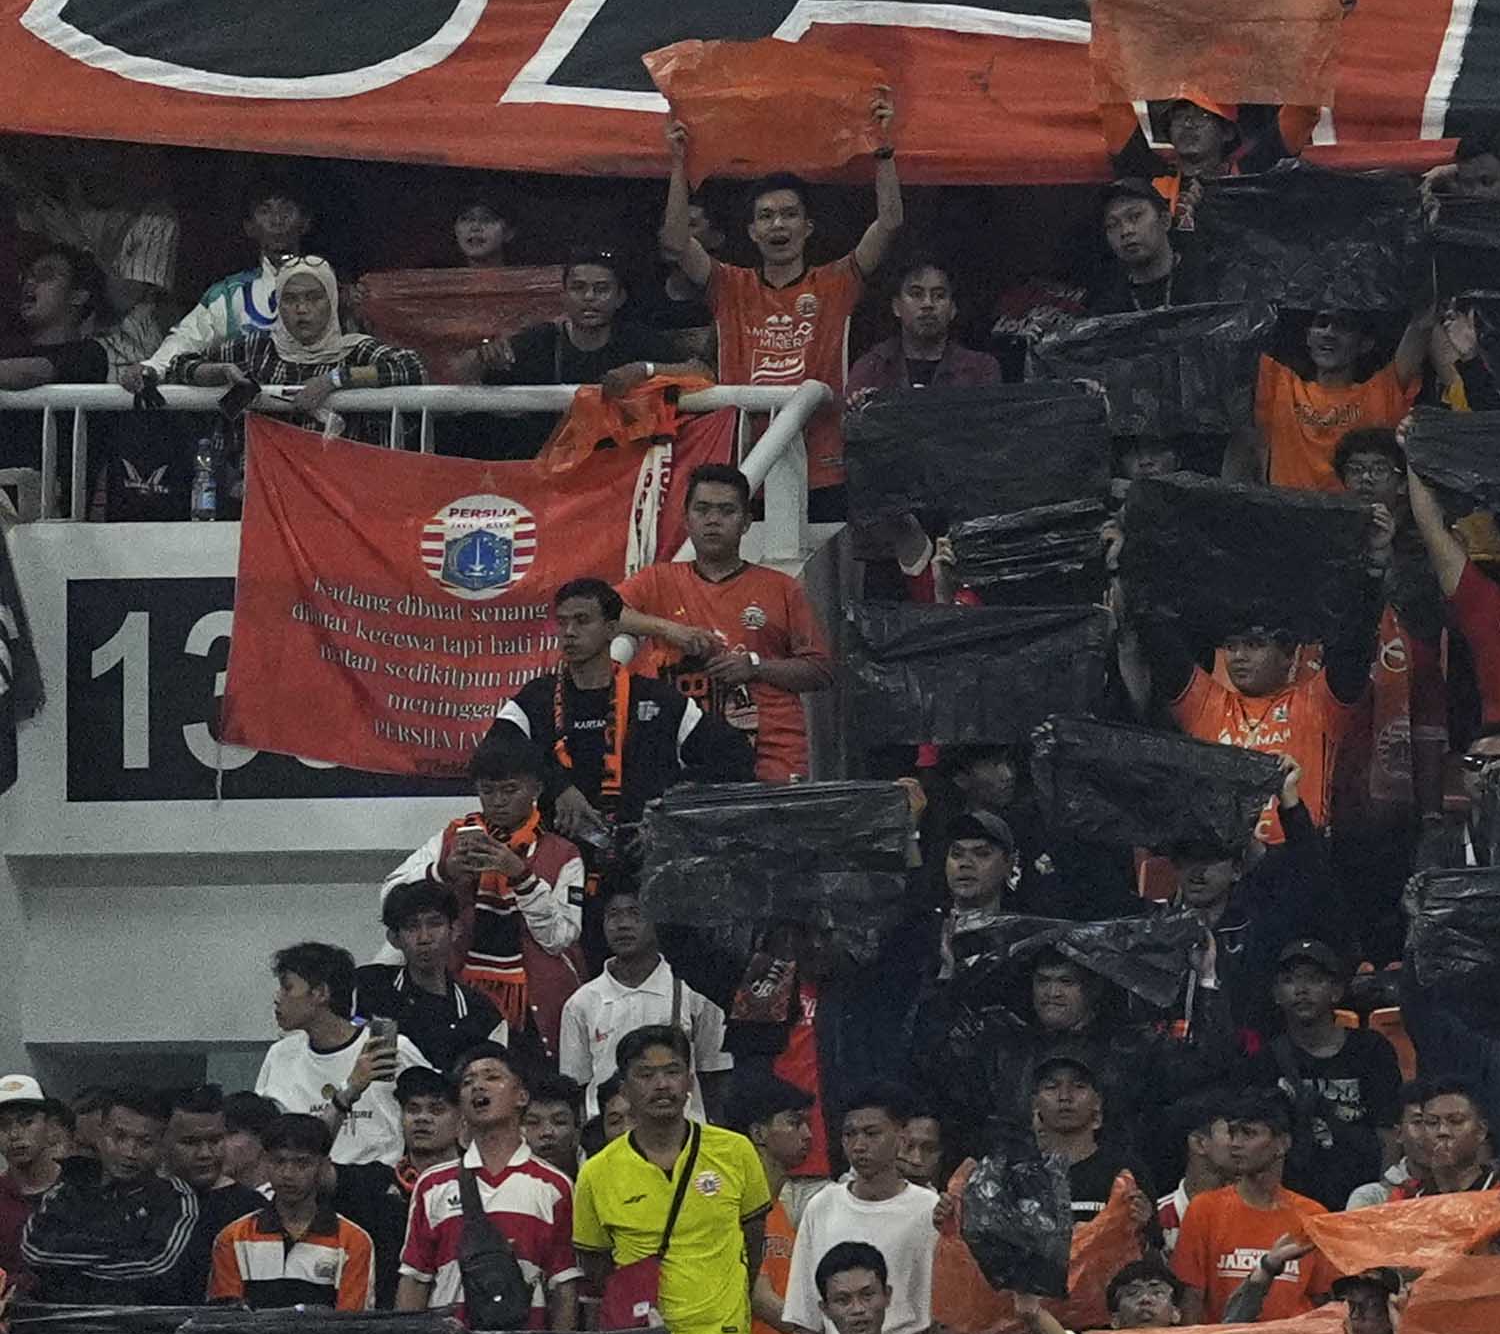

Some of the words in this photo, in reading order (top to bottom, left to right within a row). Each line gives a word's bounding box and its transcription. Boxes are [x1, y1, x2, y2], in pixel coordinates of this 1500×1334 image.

[449, 506, 517, 519] PERSIJA
[396, 595, 463, 621] dibuat
[471, 602, 549, 621] senang
[355, 619, 434, 653] kecewa
[442, 632, 484, 659] tapi
[491, 634, 532, 655] hati
[384, 661, 502, 691] sedikitpun
[1216, 1253, 1301, 1275] JAKMIA
